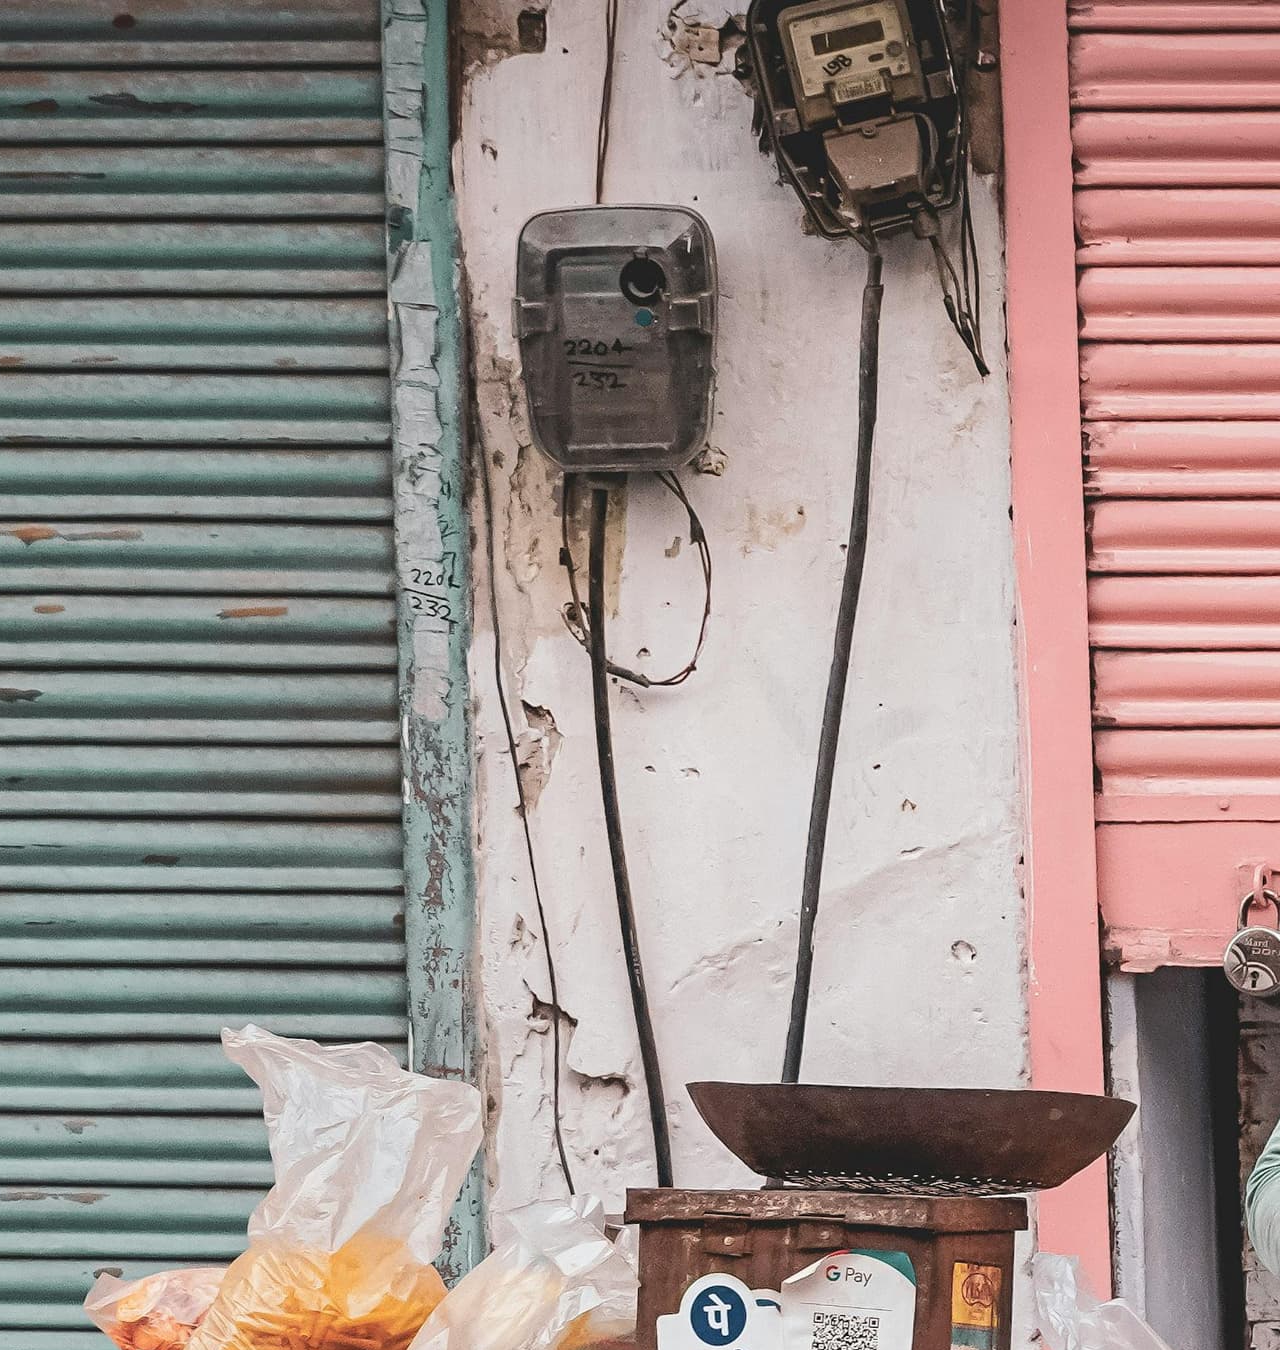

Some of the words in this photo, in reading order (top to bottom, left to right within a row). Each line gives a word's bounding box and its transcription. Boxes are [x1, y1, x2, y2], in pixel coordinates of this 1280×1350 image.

[411, 596, 459, 624] 232
[825, 1265, 841, 1282] G
[845, 1267, 873, 1287] Pay
